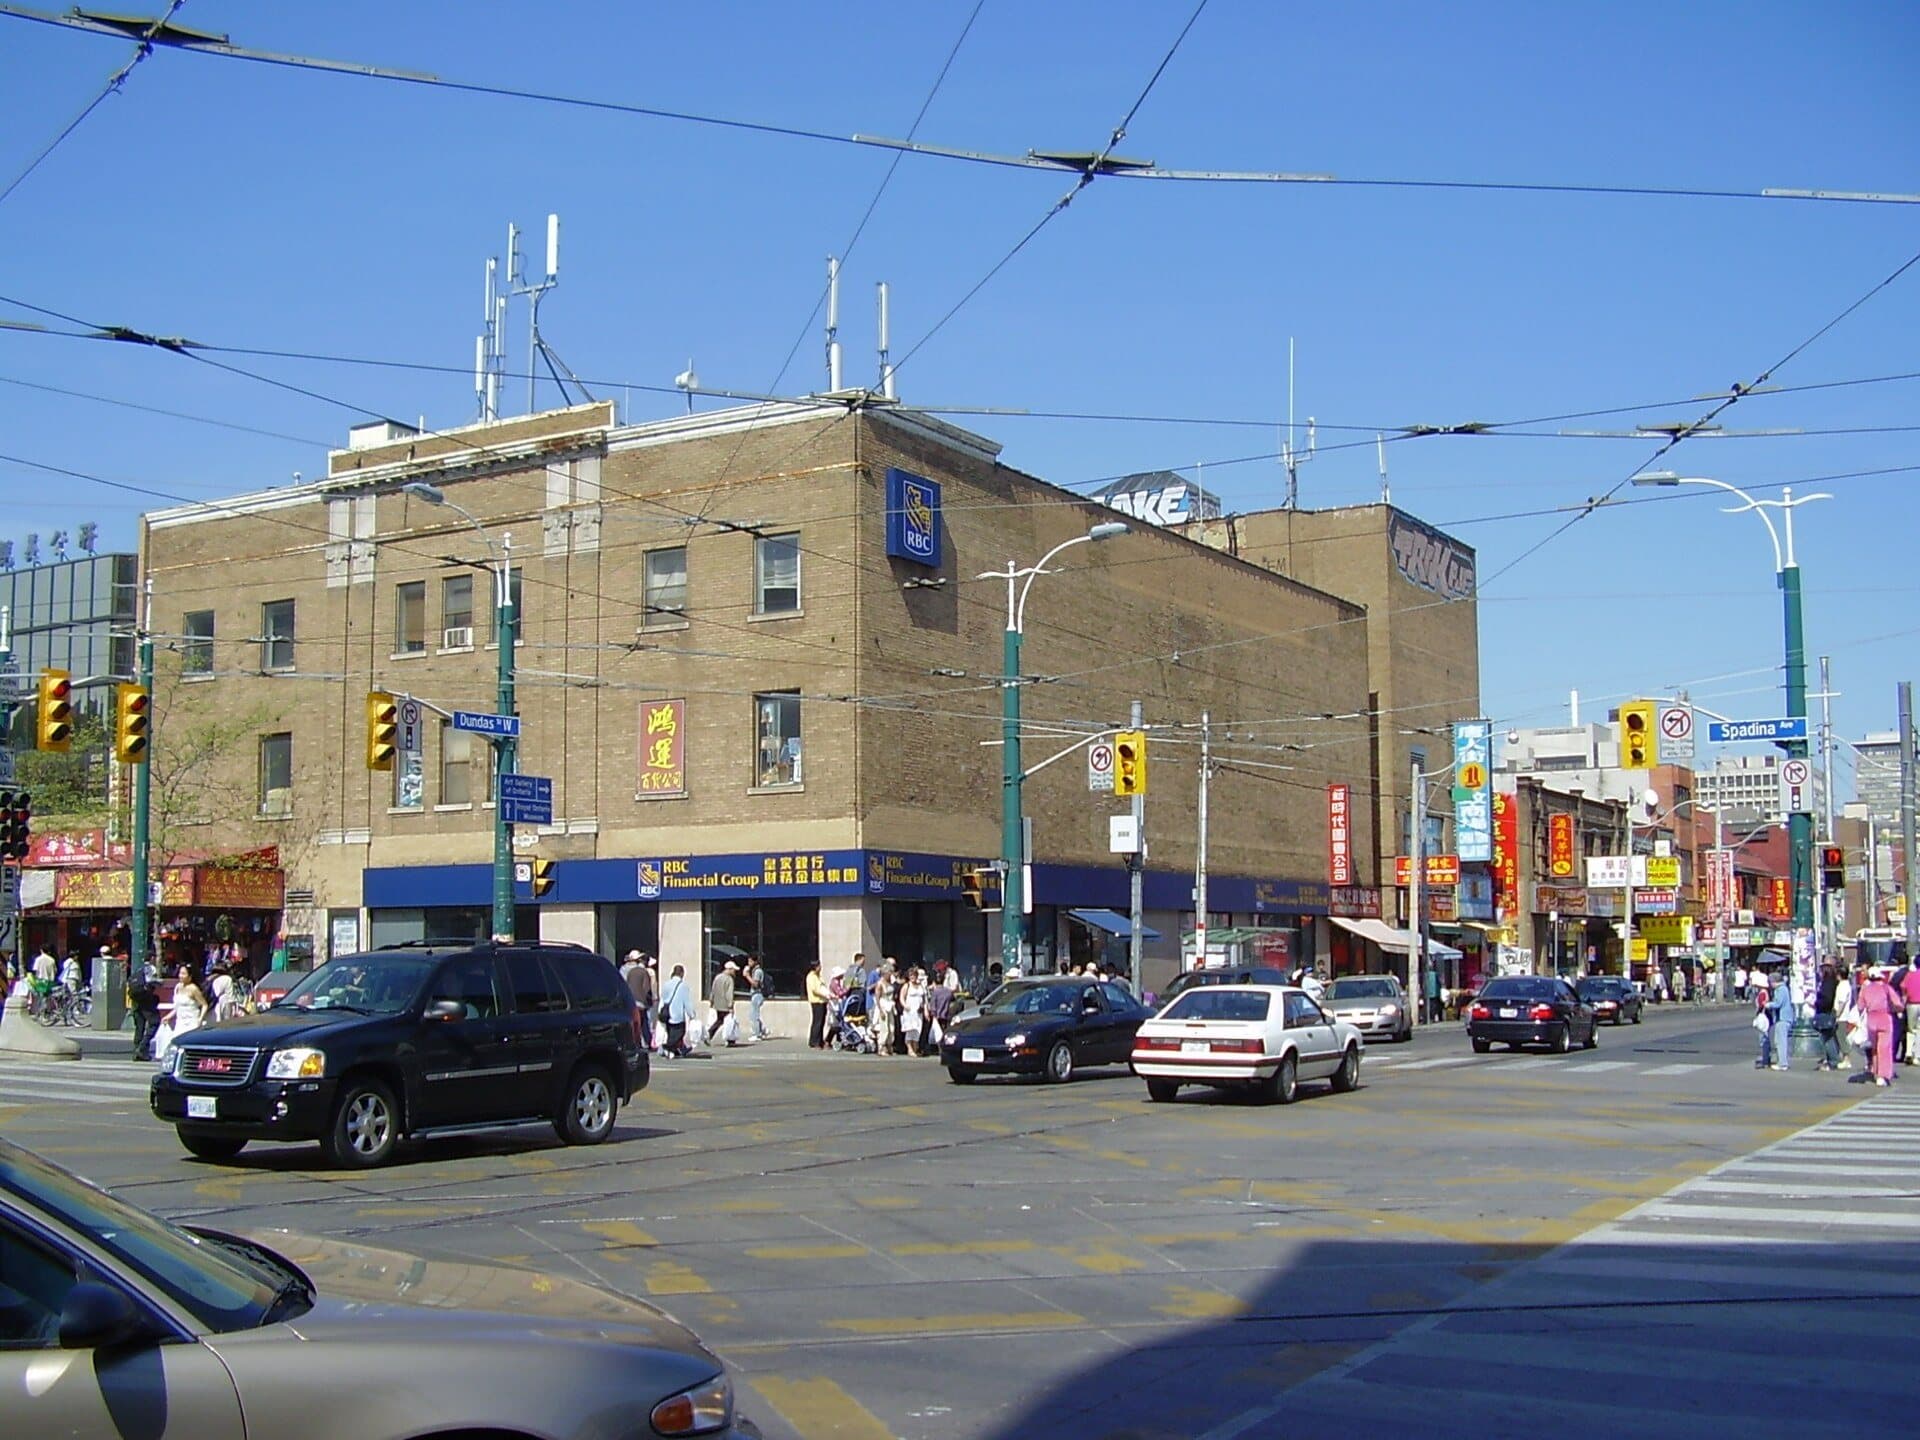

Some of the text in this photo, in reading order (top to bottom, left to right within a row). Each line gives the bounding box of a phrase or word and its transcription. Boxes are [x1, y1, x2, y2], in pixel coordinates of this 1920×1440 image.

[907, 531, 930, 551] RBC
[460, 713, 494, 729] Dundas
[503, 719, 512, 732] W
[1721, 721, 1794, 739] Spadina Ave
[663, 861, 689, 873] RBC
[886, 856, 904, 869] RBC
[663, 873, 759, 889] Financial Group
[886, 872, 923, 886] Financial
[925, 873, 950, 889] Group
[640, 886, 658, 895] RBC
